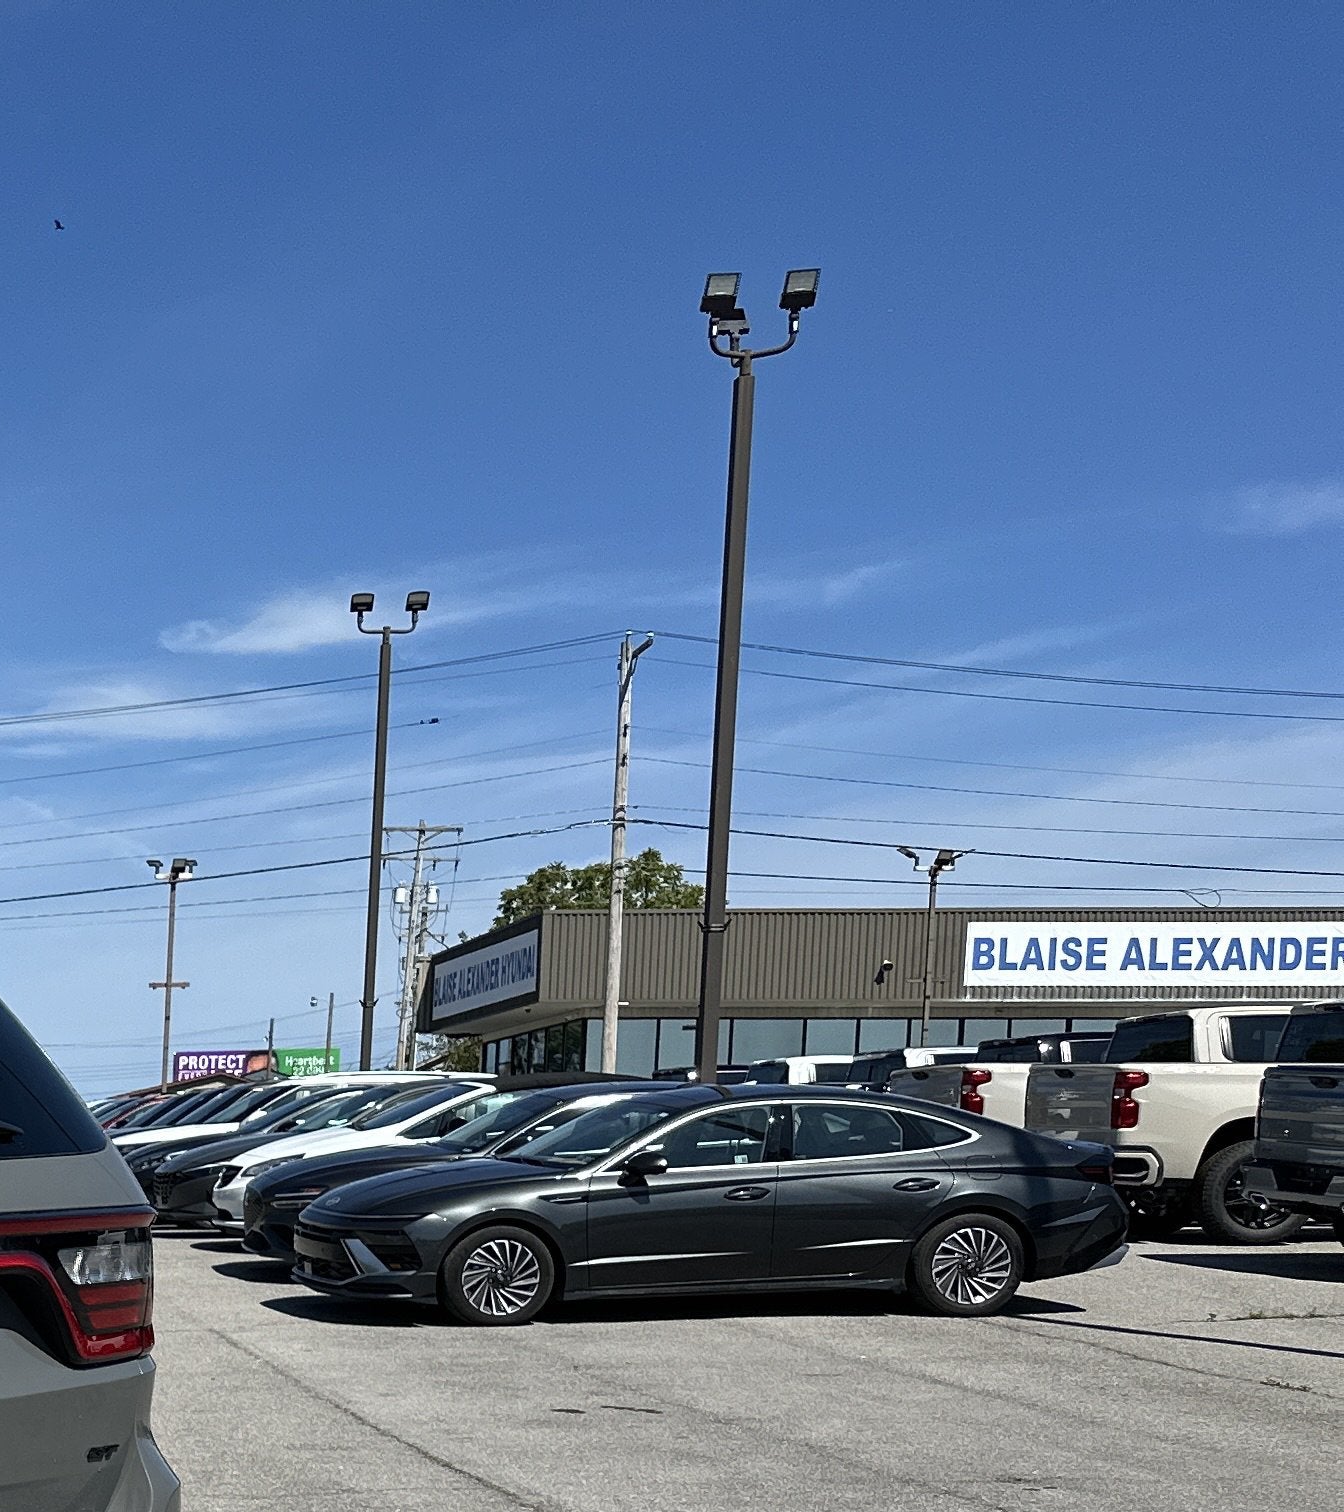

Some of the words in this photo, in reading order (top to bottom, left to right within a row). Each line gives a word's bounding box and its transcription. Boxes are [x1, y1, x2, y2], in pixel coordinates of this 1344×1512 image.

[971, 936, 1109, 971] BLAISE
[1119, 936, 1344, 971] ALEXANDER
[457, 957, 500, 1001] ALEXANDER
[500, 943, 536, 988] HYUNDAI
[178, 1054, 246, 1070] PROTECT
[284, 1054, 336, 1067] Heartbet
